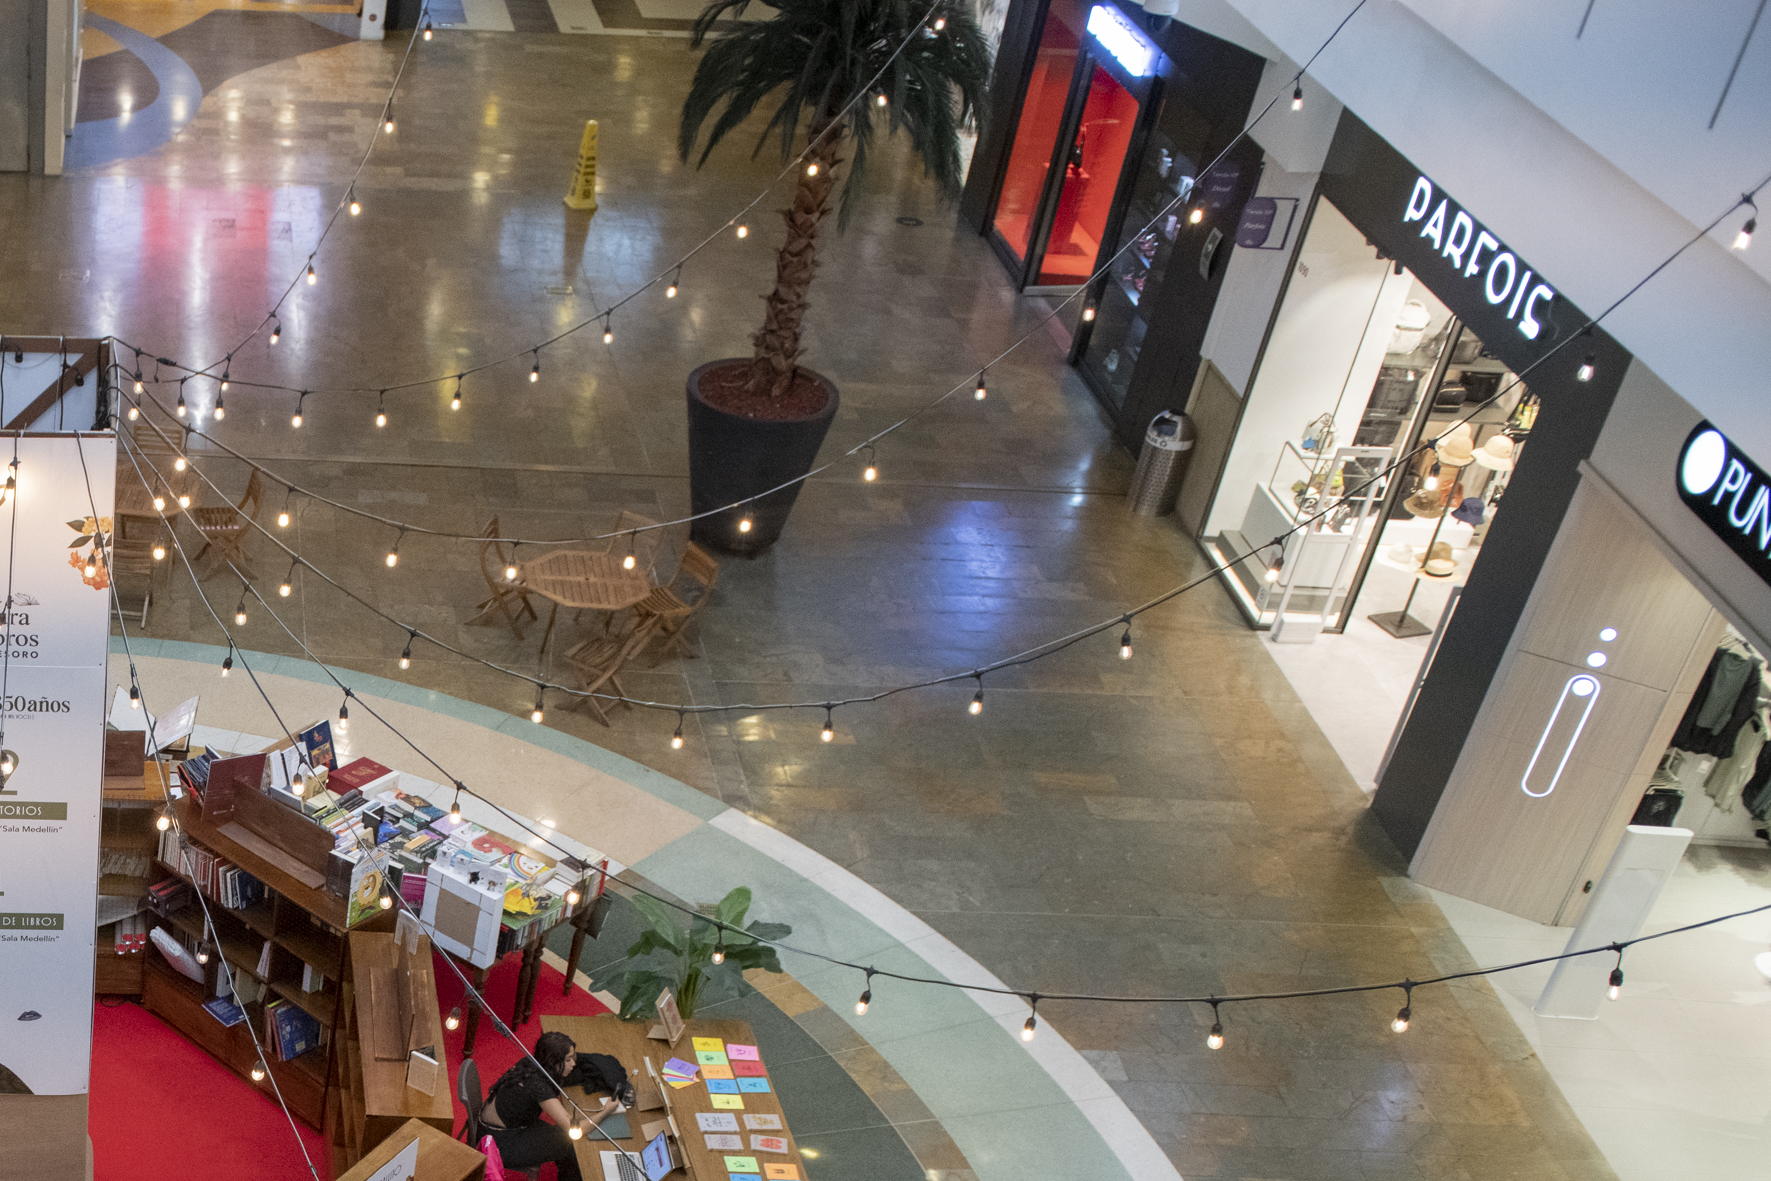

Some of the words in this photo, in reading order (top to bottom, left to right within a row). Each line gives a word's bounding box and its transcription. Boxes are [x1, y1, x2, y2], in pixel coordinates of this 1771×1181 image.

[1403, 176, 1555, 340] PARFOIS
[1712, 457, 1771, 560] PUN
[2, 917, 16, 926] DE
[21, 916, 58, 927] LIBROS
